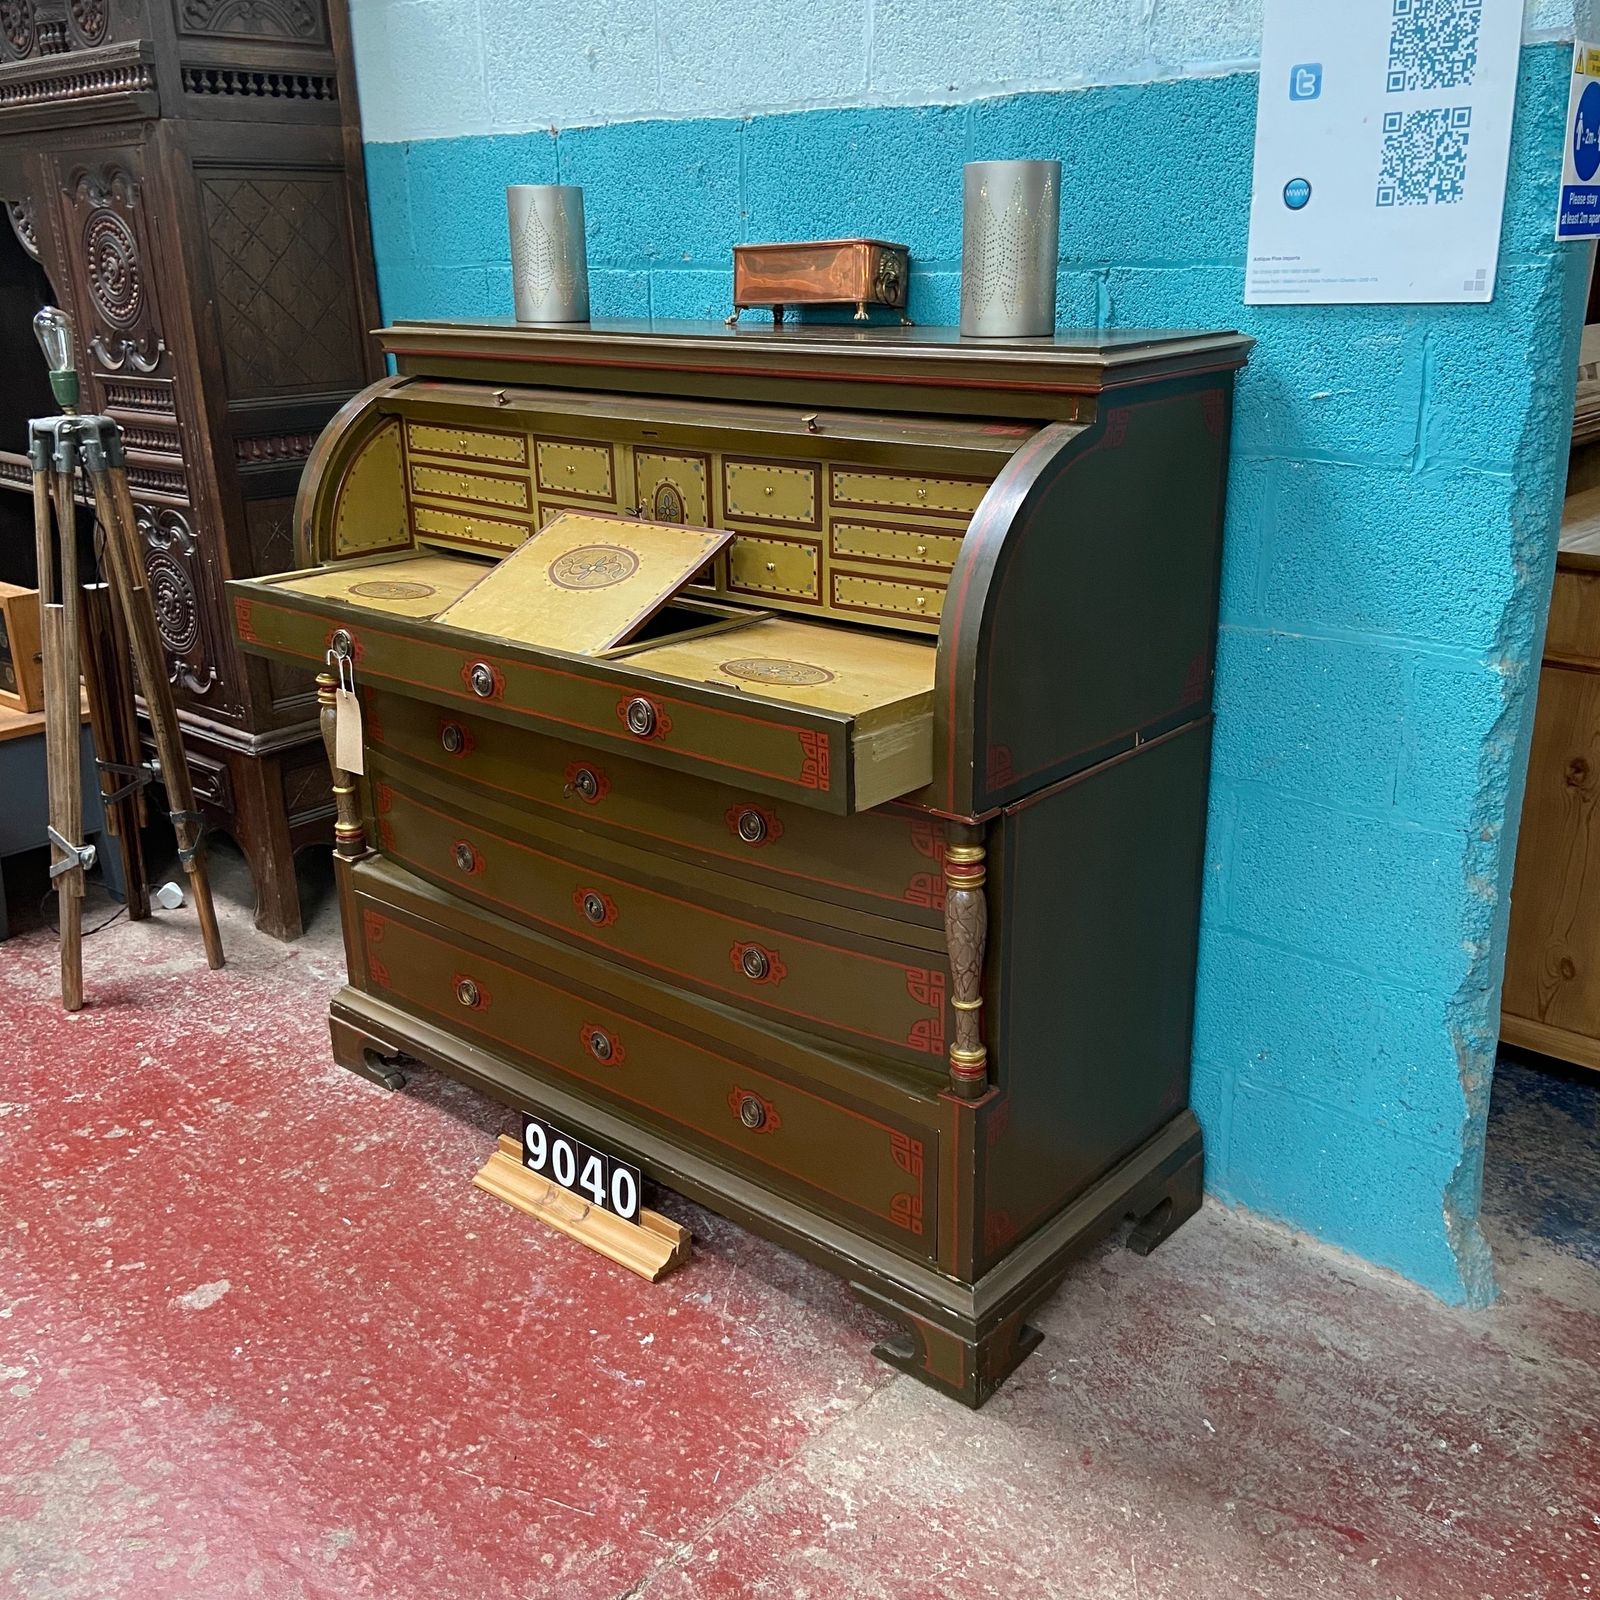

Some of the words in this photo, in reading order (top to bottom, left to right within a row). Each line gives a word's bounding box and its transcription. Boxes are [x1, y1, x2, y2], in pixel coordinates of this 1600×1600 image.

[1569, 192, 1586, 205] Please
[1586, 193, 1598, 207] stay
[1561, 213, 1567, 225] at
[1567, 211, 1579, 224] least
[1580, 212, 1588, 224] 2m
[1588, 214, 1600, 226] apar
[525, 1122, 637, 1219] 9040
